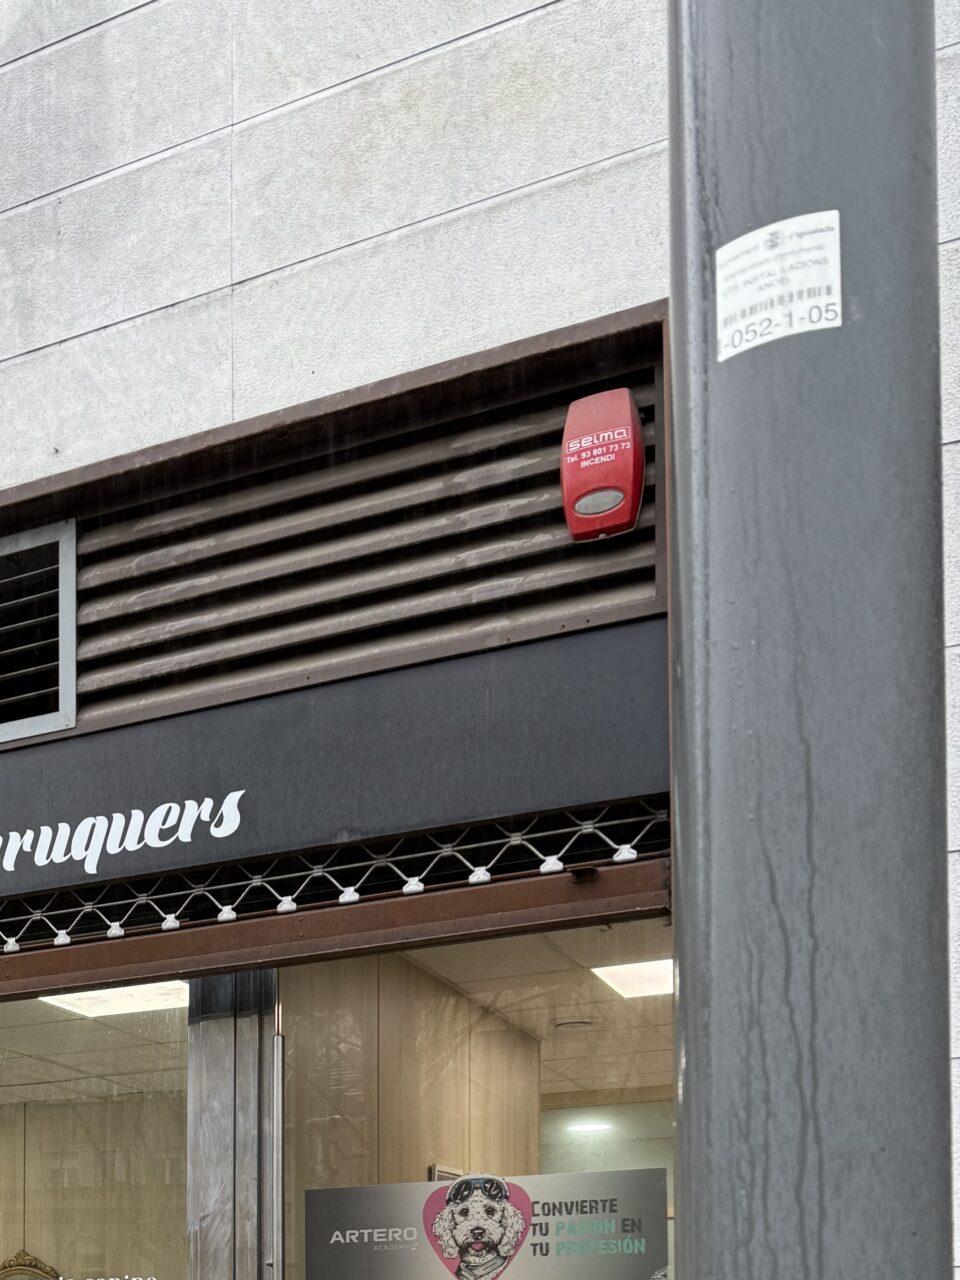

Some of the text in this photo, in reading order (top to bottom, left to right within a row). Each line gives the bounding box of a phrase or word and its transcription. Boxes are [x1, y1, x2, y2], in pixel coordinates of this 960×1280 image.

[609, 444, 619, 453] 73
[621, 442, 631, 450] 73
[531, 1198, 618, 1217] CONVIERTE
[329, 1227, 418, 1244] ARTERO
[530, 1222, 550, 1237] TU
[621, 1218, 642, 1234] EN
[530, 1242, 550, 1257] TU
